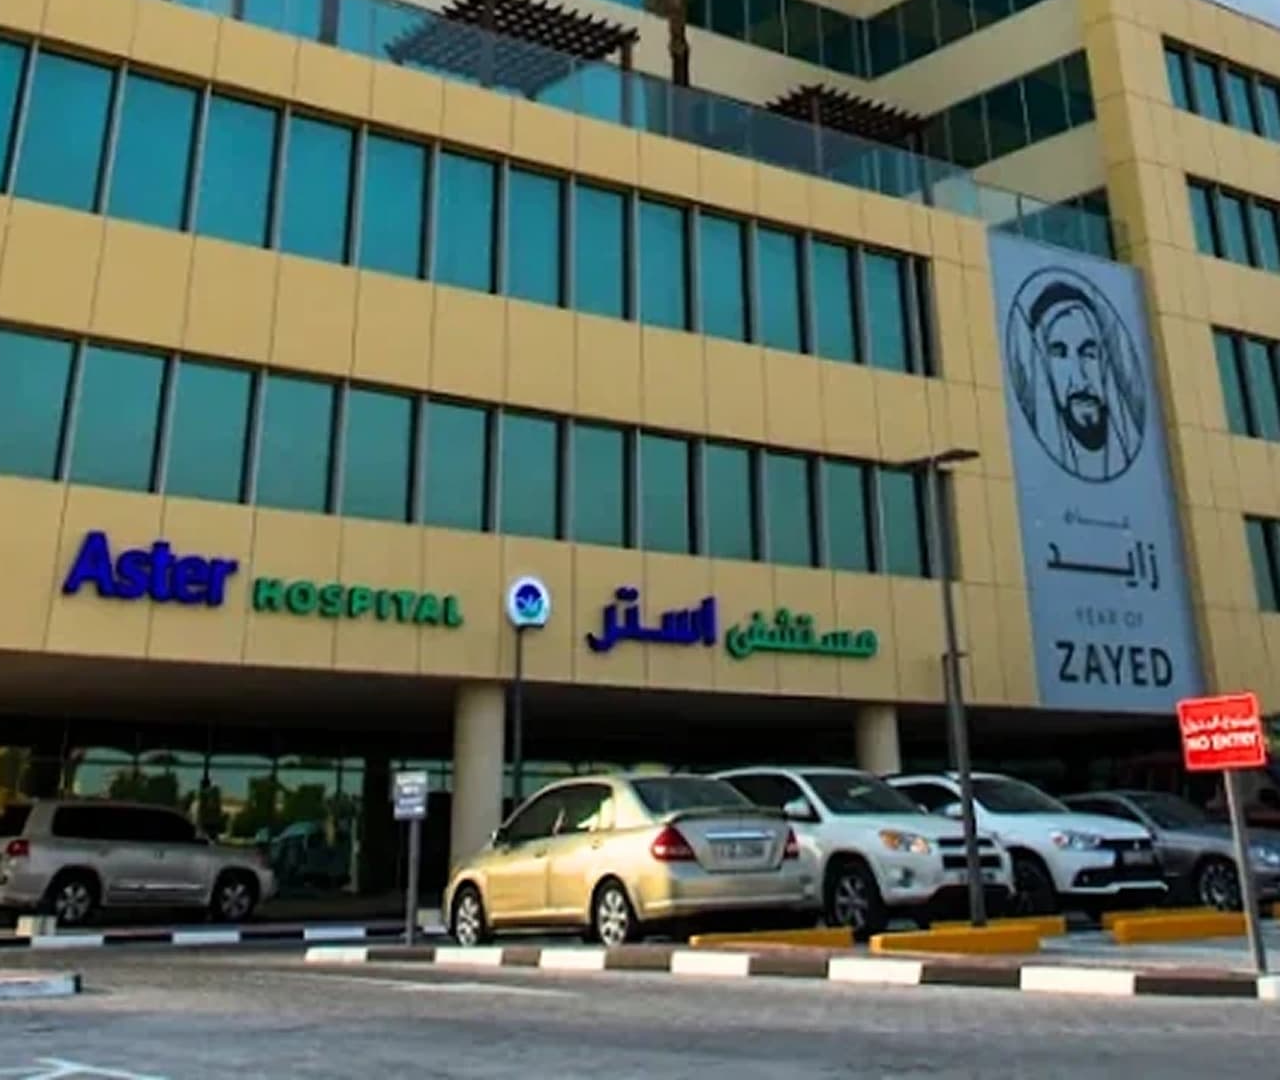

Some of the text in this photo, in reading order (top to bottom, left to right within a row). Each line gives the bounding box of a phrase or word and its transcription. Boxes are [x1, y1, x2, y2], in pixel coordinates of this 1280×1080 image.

[61, 530, 464, 629] Aster HOSPITAL
[1046, 540, 1160, 592] زايد
[725, 607, 879, 661] مستشفى
[1054, 639, 1174, 688] ZAYED
[1185, 731, 1259, 752] NO ENTRY
